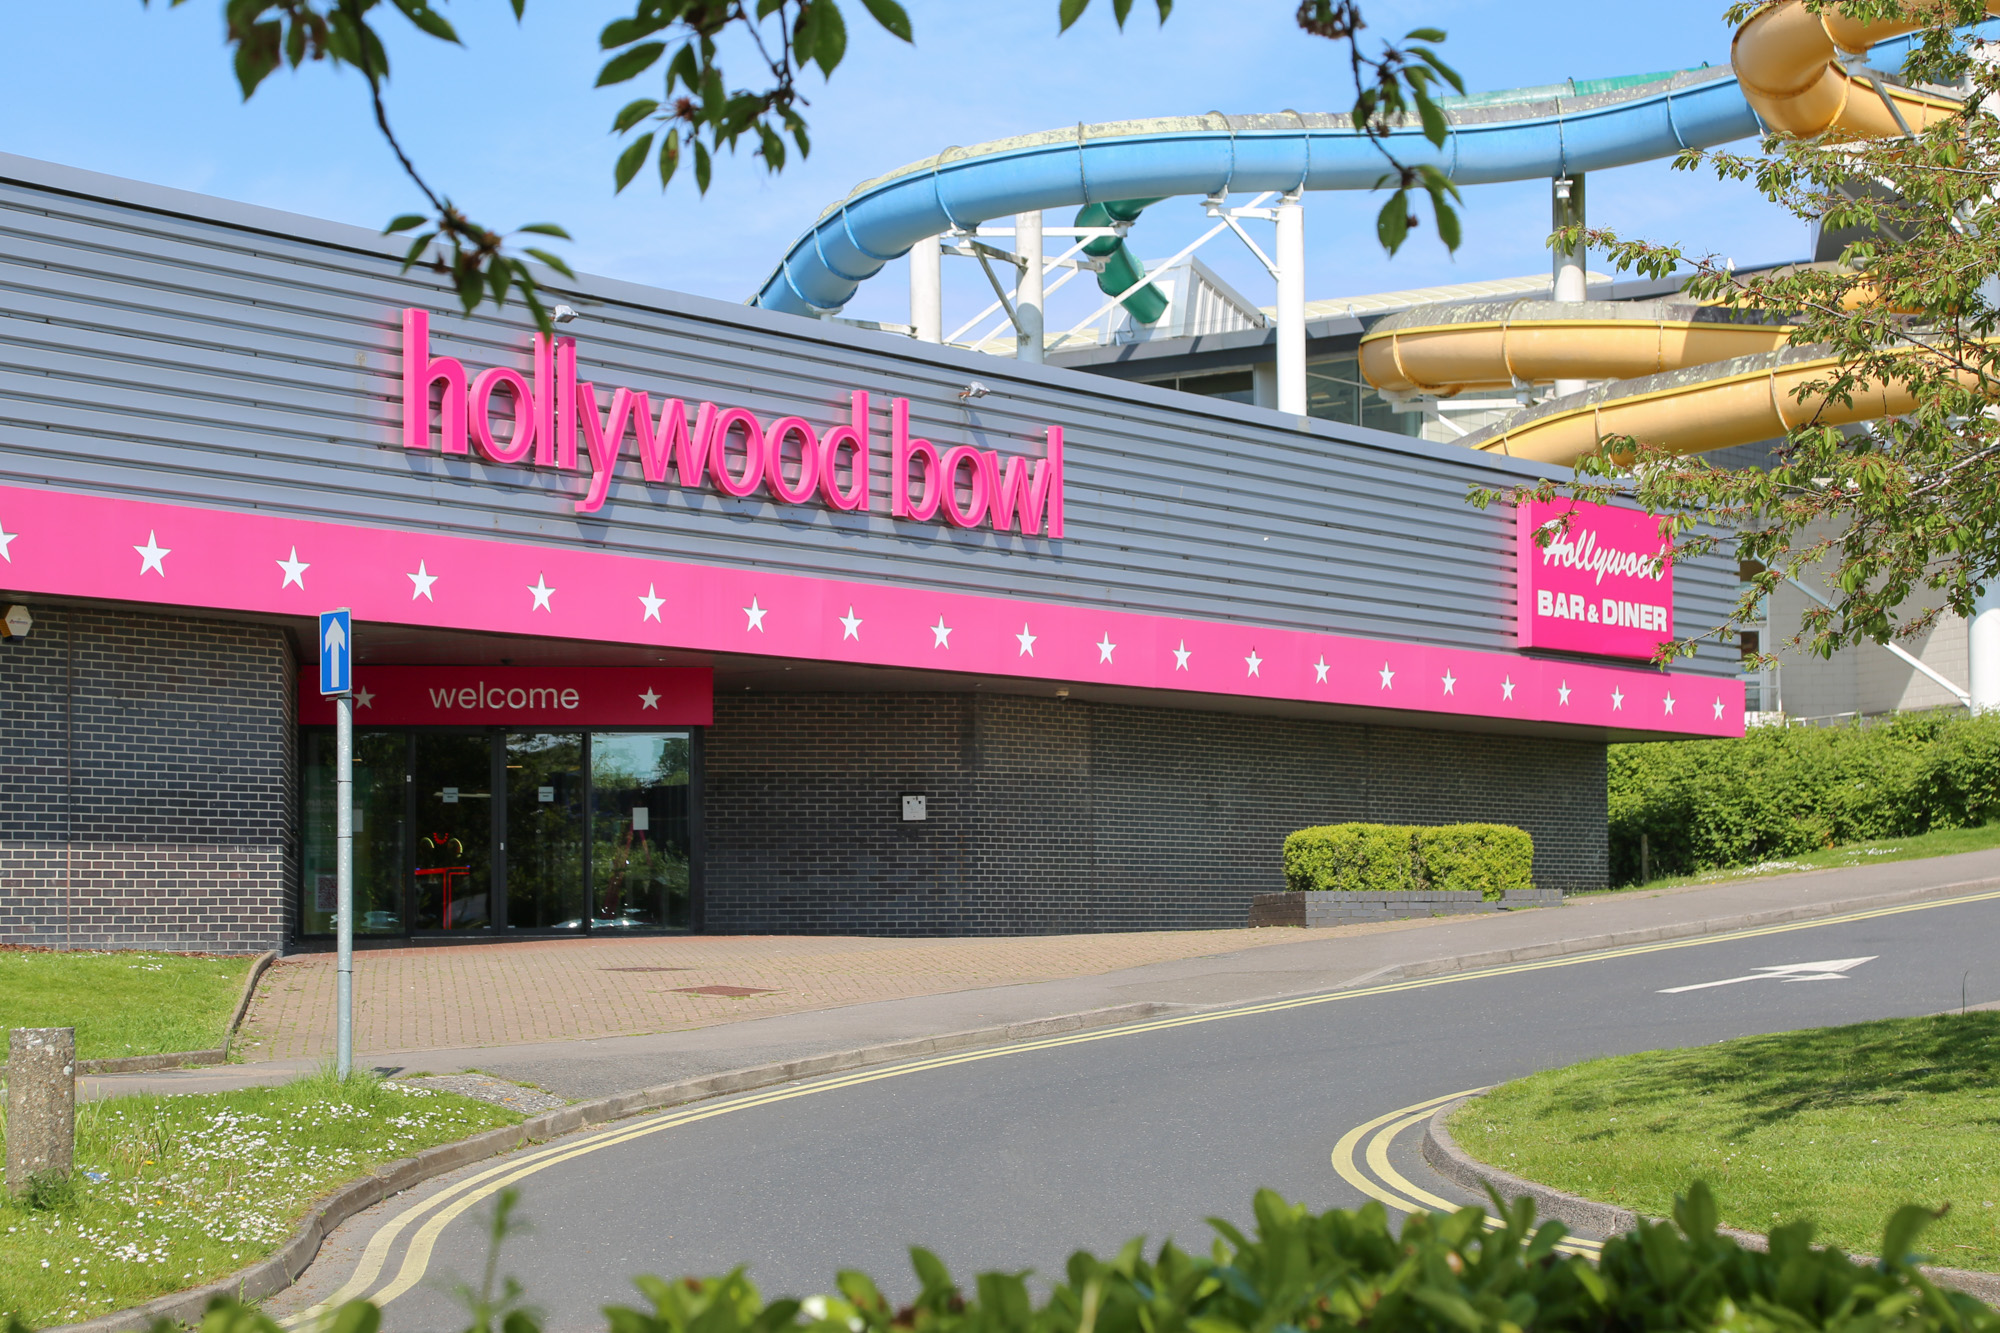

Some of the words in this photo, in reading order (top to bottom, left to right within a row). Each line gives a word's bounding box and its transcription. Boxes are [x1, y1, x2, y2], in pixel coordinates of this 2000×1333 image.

[402, 308, 869, 512] hollywood
[892, 397, 1064, 539] bowl
[1539, 519, 1666, 586] Hollywood
[1537, 589, 1585, 621] BAR
[1587, 603, 1600, 623] &
[1602, 598, 1667, 632] DINER
[429, 682, 580, 709] welcome
